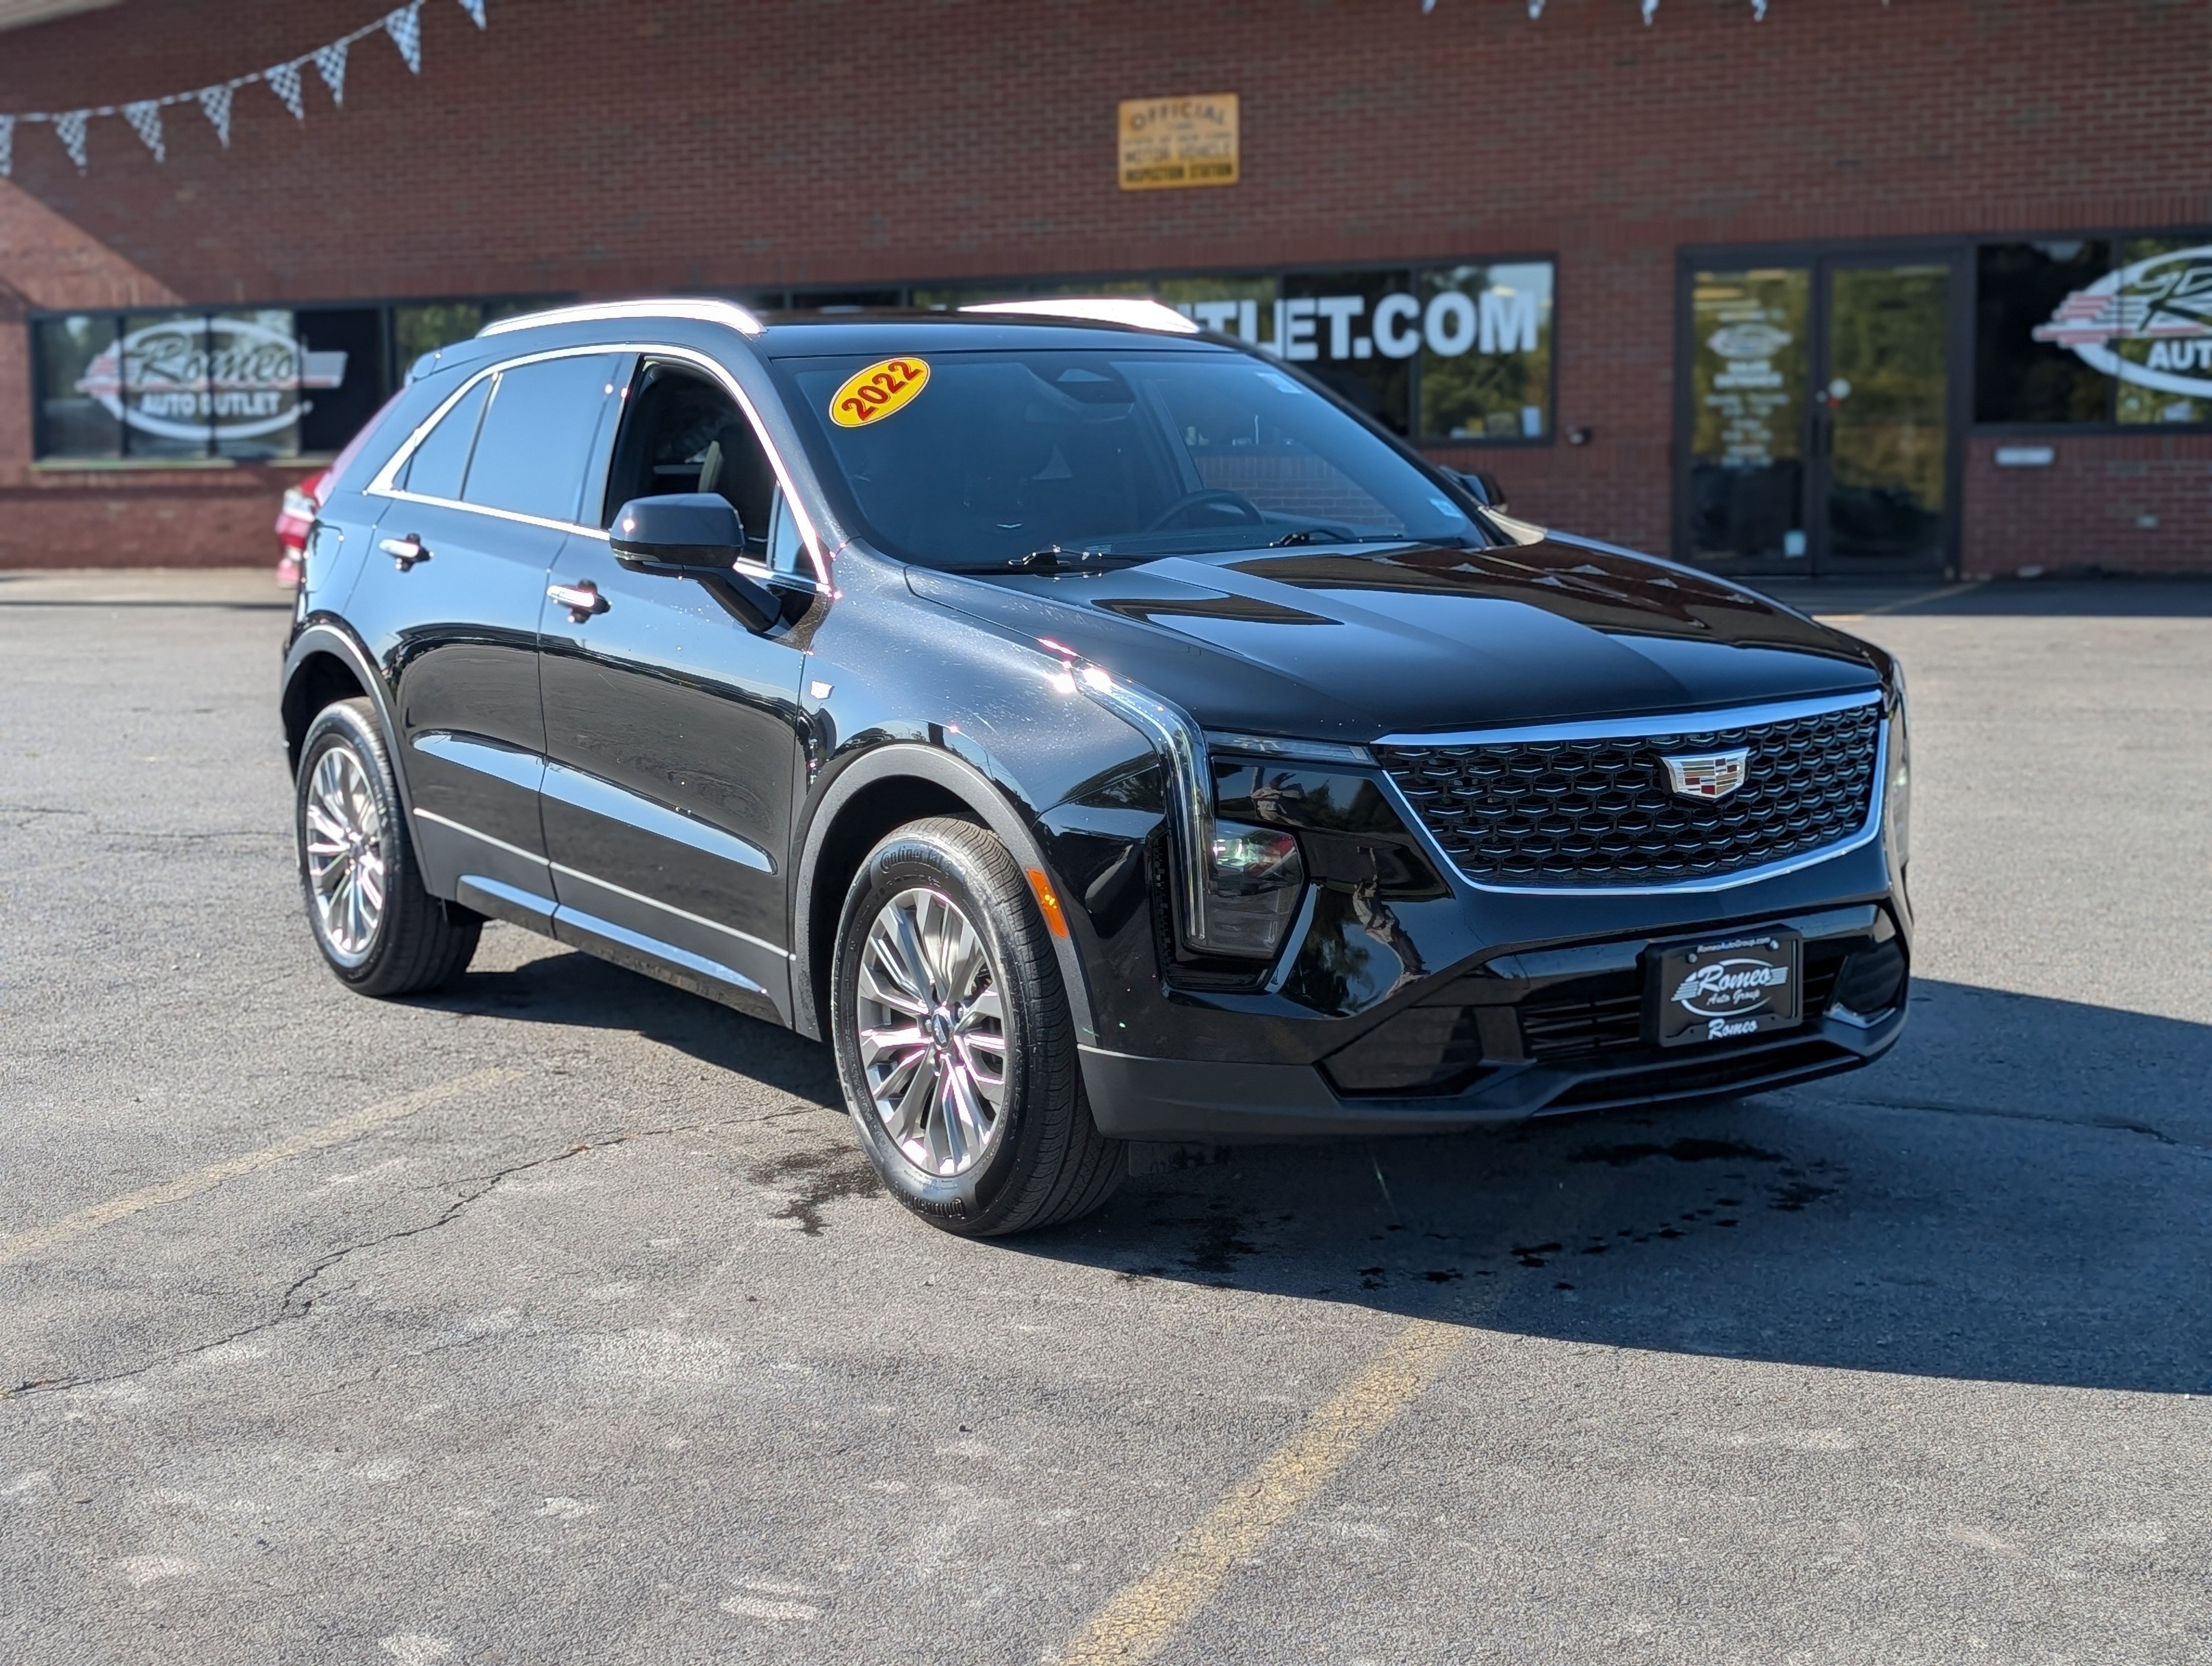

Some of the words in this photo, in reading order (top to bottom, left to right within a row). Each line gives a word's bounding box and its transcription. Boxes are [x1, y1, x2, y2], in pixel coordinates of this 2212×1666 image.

[1129, 102, 1225, 131] OFFICIAL
[126, 331, 293, 384] Romeo
[142, 392, 196, 416] AUTO
[841, 361, 924, 421] 2022
[1697, 965, 1771, 996] Romeo
[1707, 992, 1731, 1006] Auto
[1733, 989, 1760, 1004] Group
[1708, 1018, 1758, 1040] Romeo
